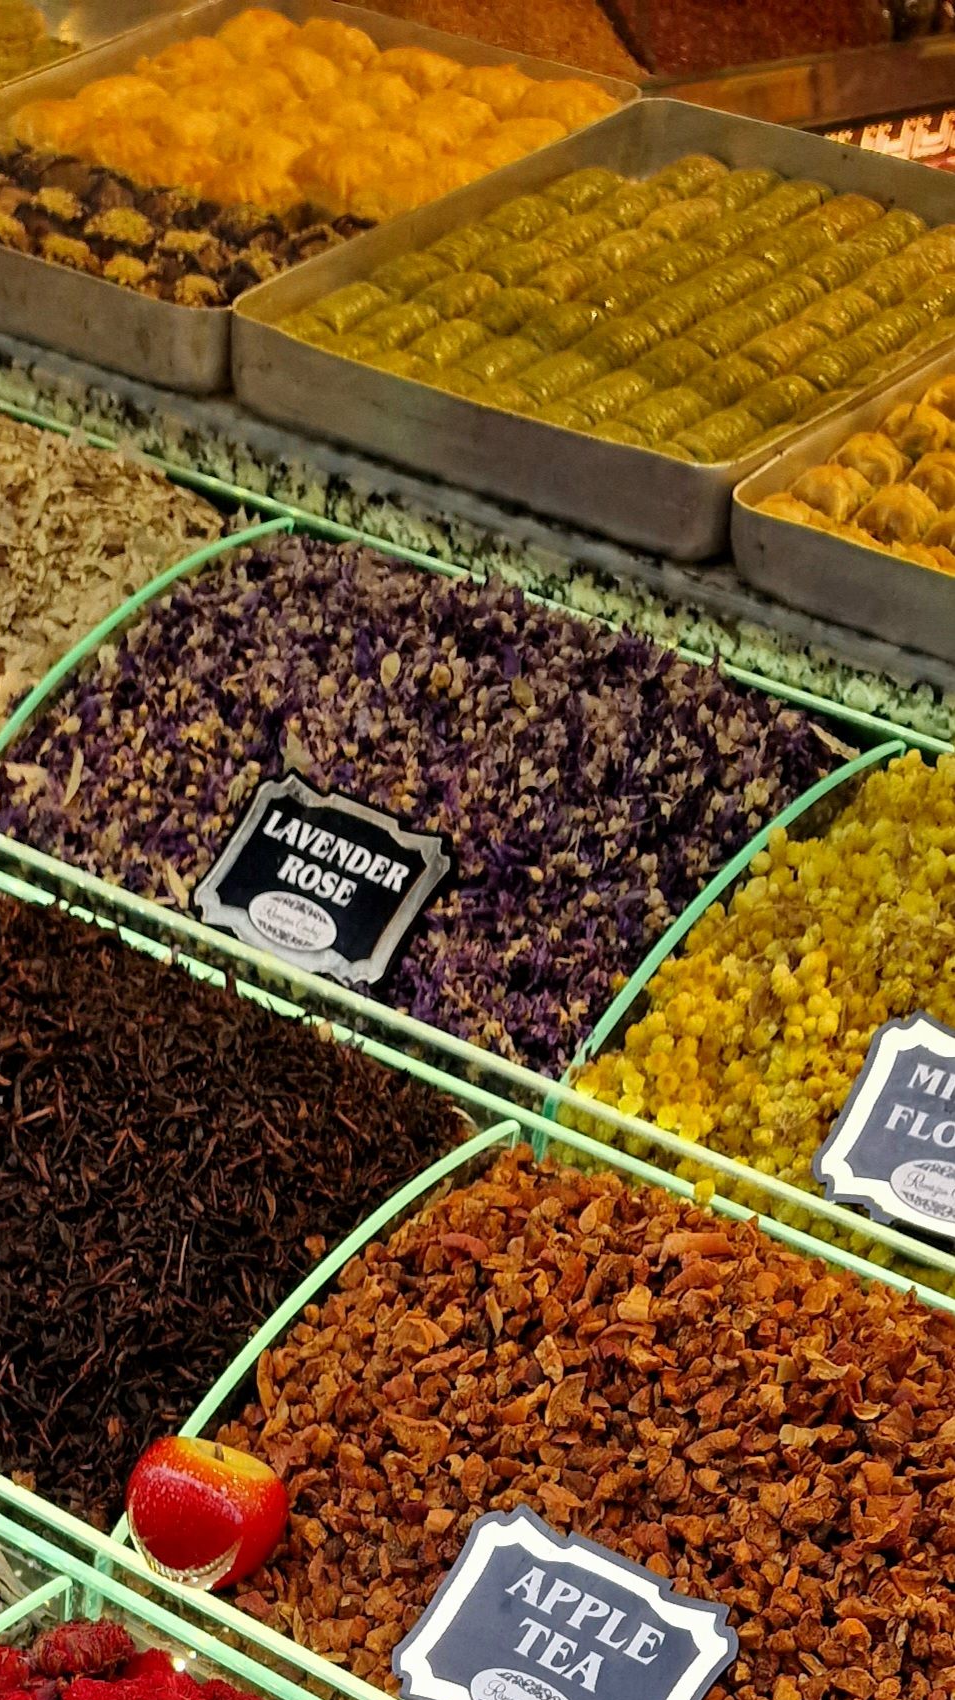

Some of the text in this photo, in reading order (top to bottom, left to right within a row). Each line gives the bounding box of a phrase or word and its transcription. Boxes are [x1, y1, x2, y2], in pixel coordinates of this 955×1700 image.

[262, 809, 411, 893] LAVENDER
[276, 854, 358, 908] ROSE
[884, 1103, 955, 1148] FLO
[504, 1566, 666, 1665] APPLE
[512, 1616, 606, 1694] TEA
